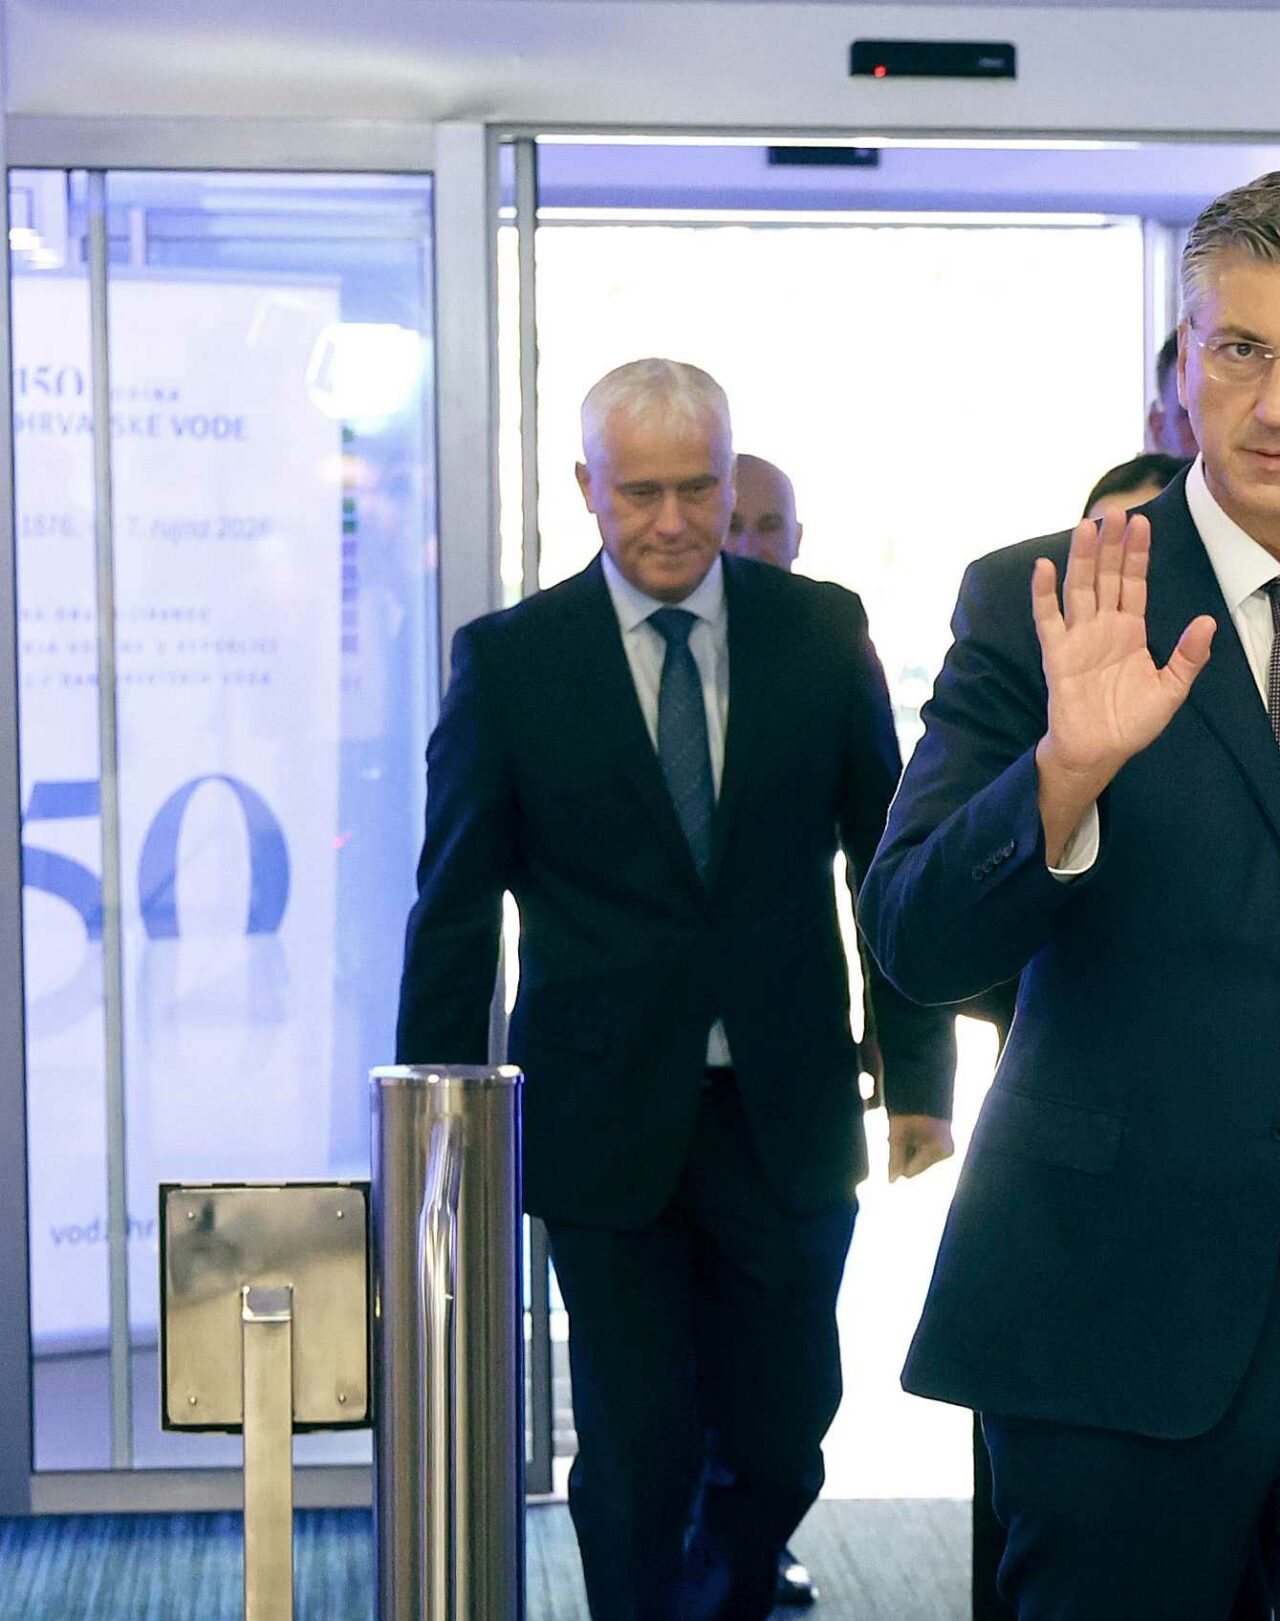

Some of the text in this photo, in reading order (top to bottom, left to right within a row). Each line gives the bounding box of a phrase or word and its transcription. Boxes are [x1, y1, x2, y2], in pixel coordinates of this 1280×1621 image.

[17, 366, 84, 397] 150
[15, 411, 249, 442] HRVASKE VODE
[49, 1214, 156, 1247] vodhr
